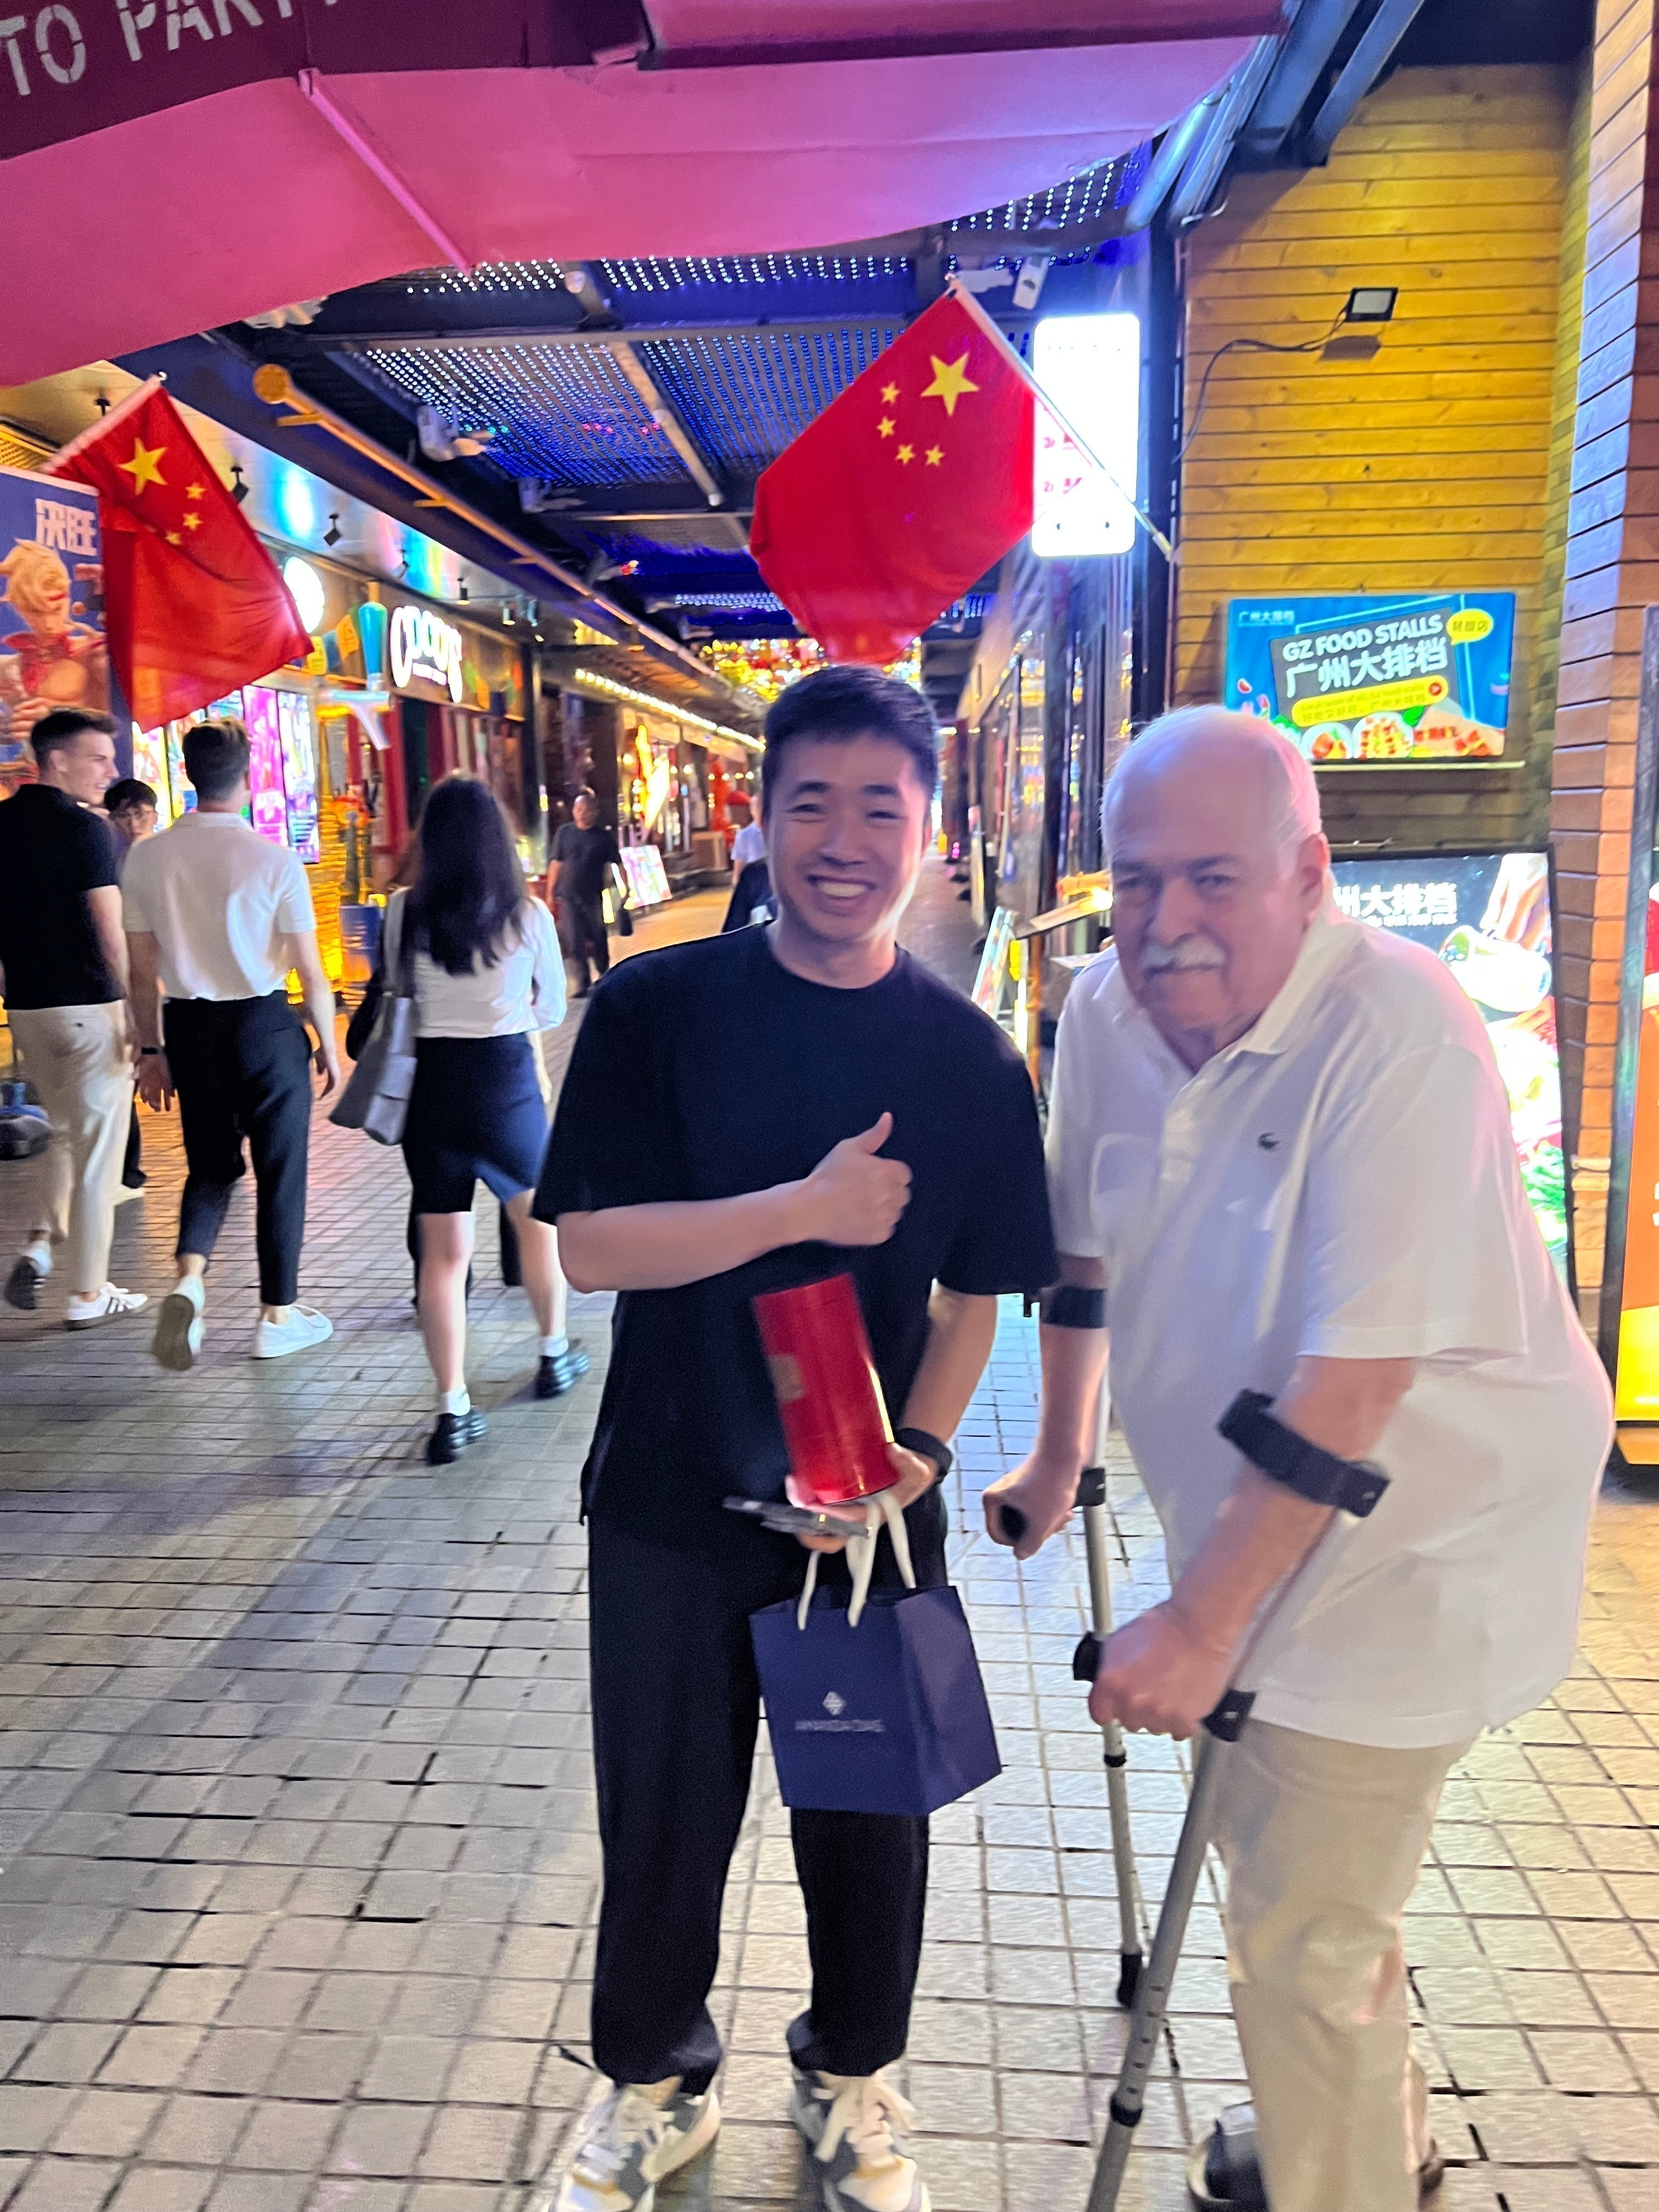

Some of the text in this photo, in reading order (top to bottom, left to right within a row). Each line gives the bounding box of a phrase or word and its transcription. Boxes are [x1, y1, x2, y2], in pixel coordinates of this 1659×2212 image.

[0, 0, 337, 95] TO PAR
[1283, 639, 1314, 662] GZ
[1316, 628, 1373, 656] FOOD
[1375, 614, 1443, 645] STALLS
[1286, 636, 1448, 698] 广州大排档
